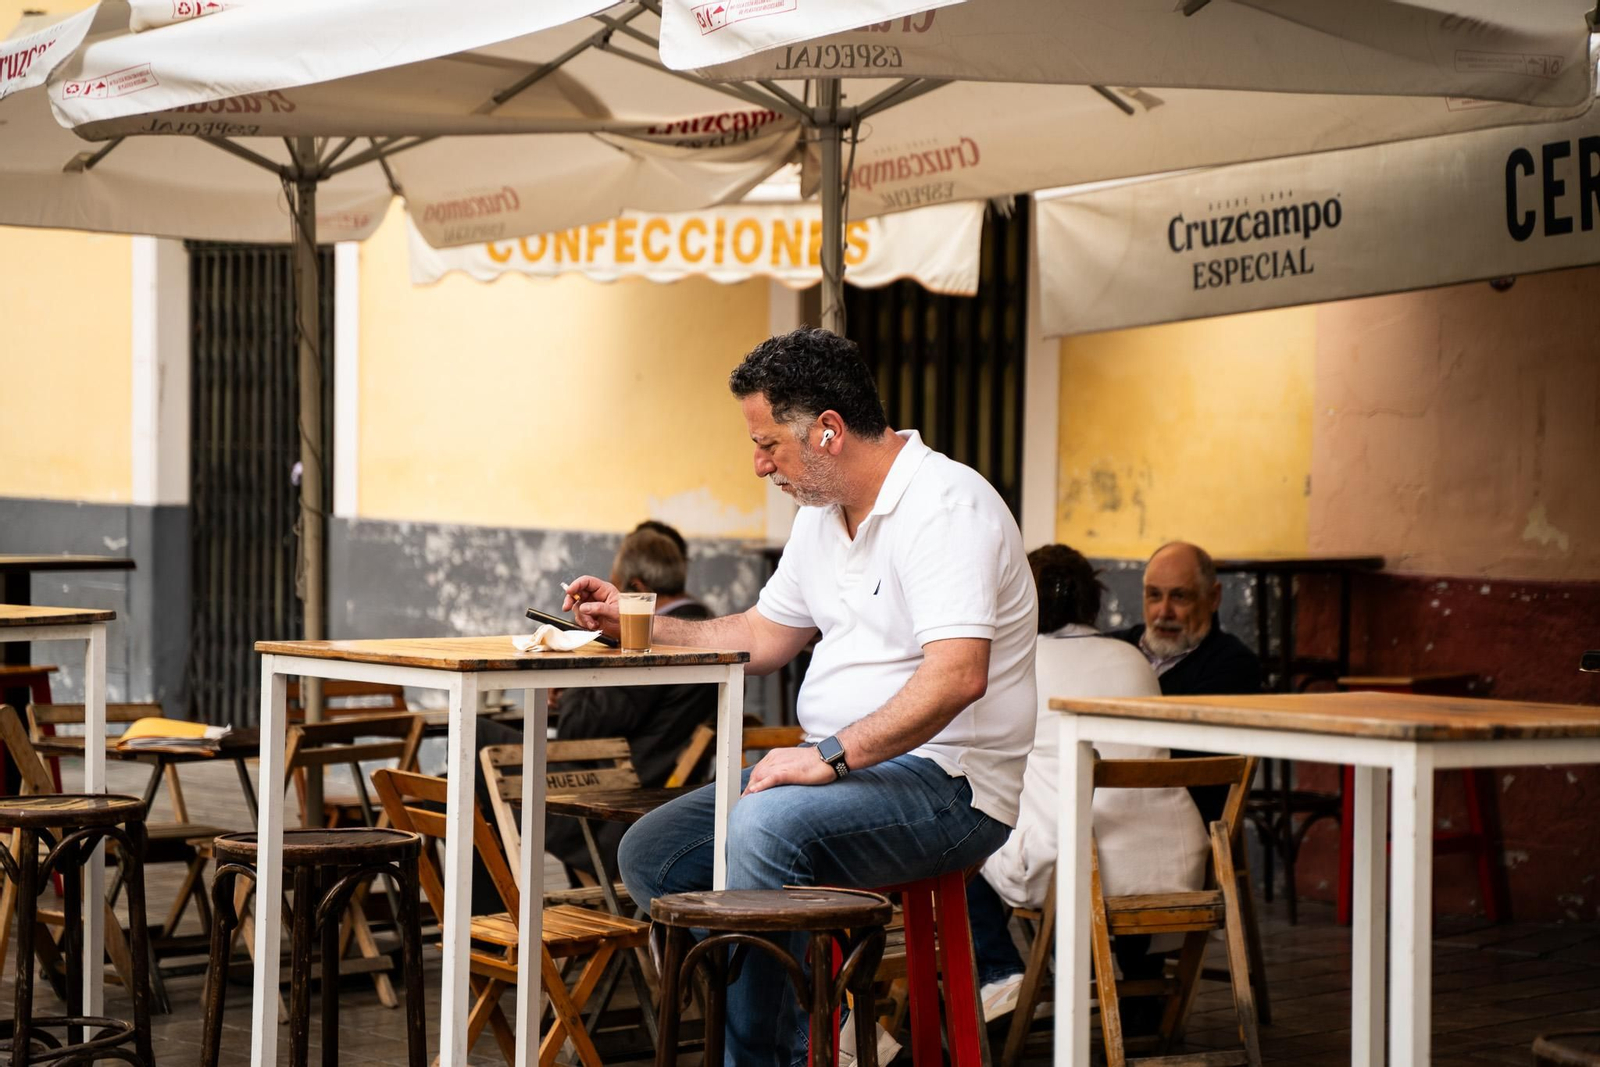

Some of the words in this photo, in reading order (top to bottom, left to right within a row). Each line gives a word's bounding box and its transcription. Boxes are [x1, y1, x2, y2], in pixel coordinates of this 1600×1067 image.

[1505, 135, 1600, 242] CER
[1168, 198, 1342, 253] Cruzcampo
[1193, 246, 1315, 290] ESPECIAL
[546, 773, 600, 789] HUELVA
